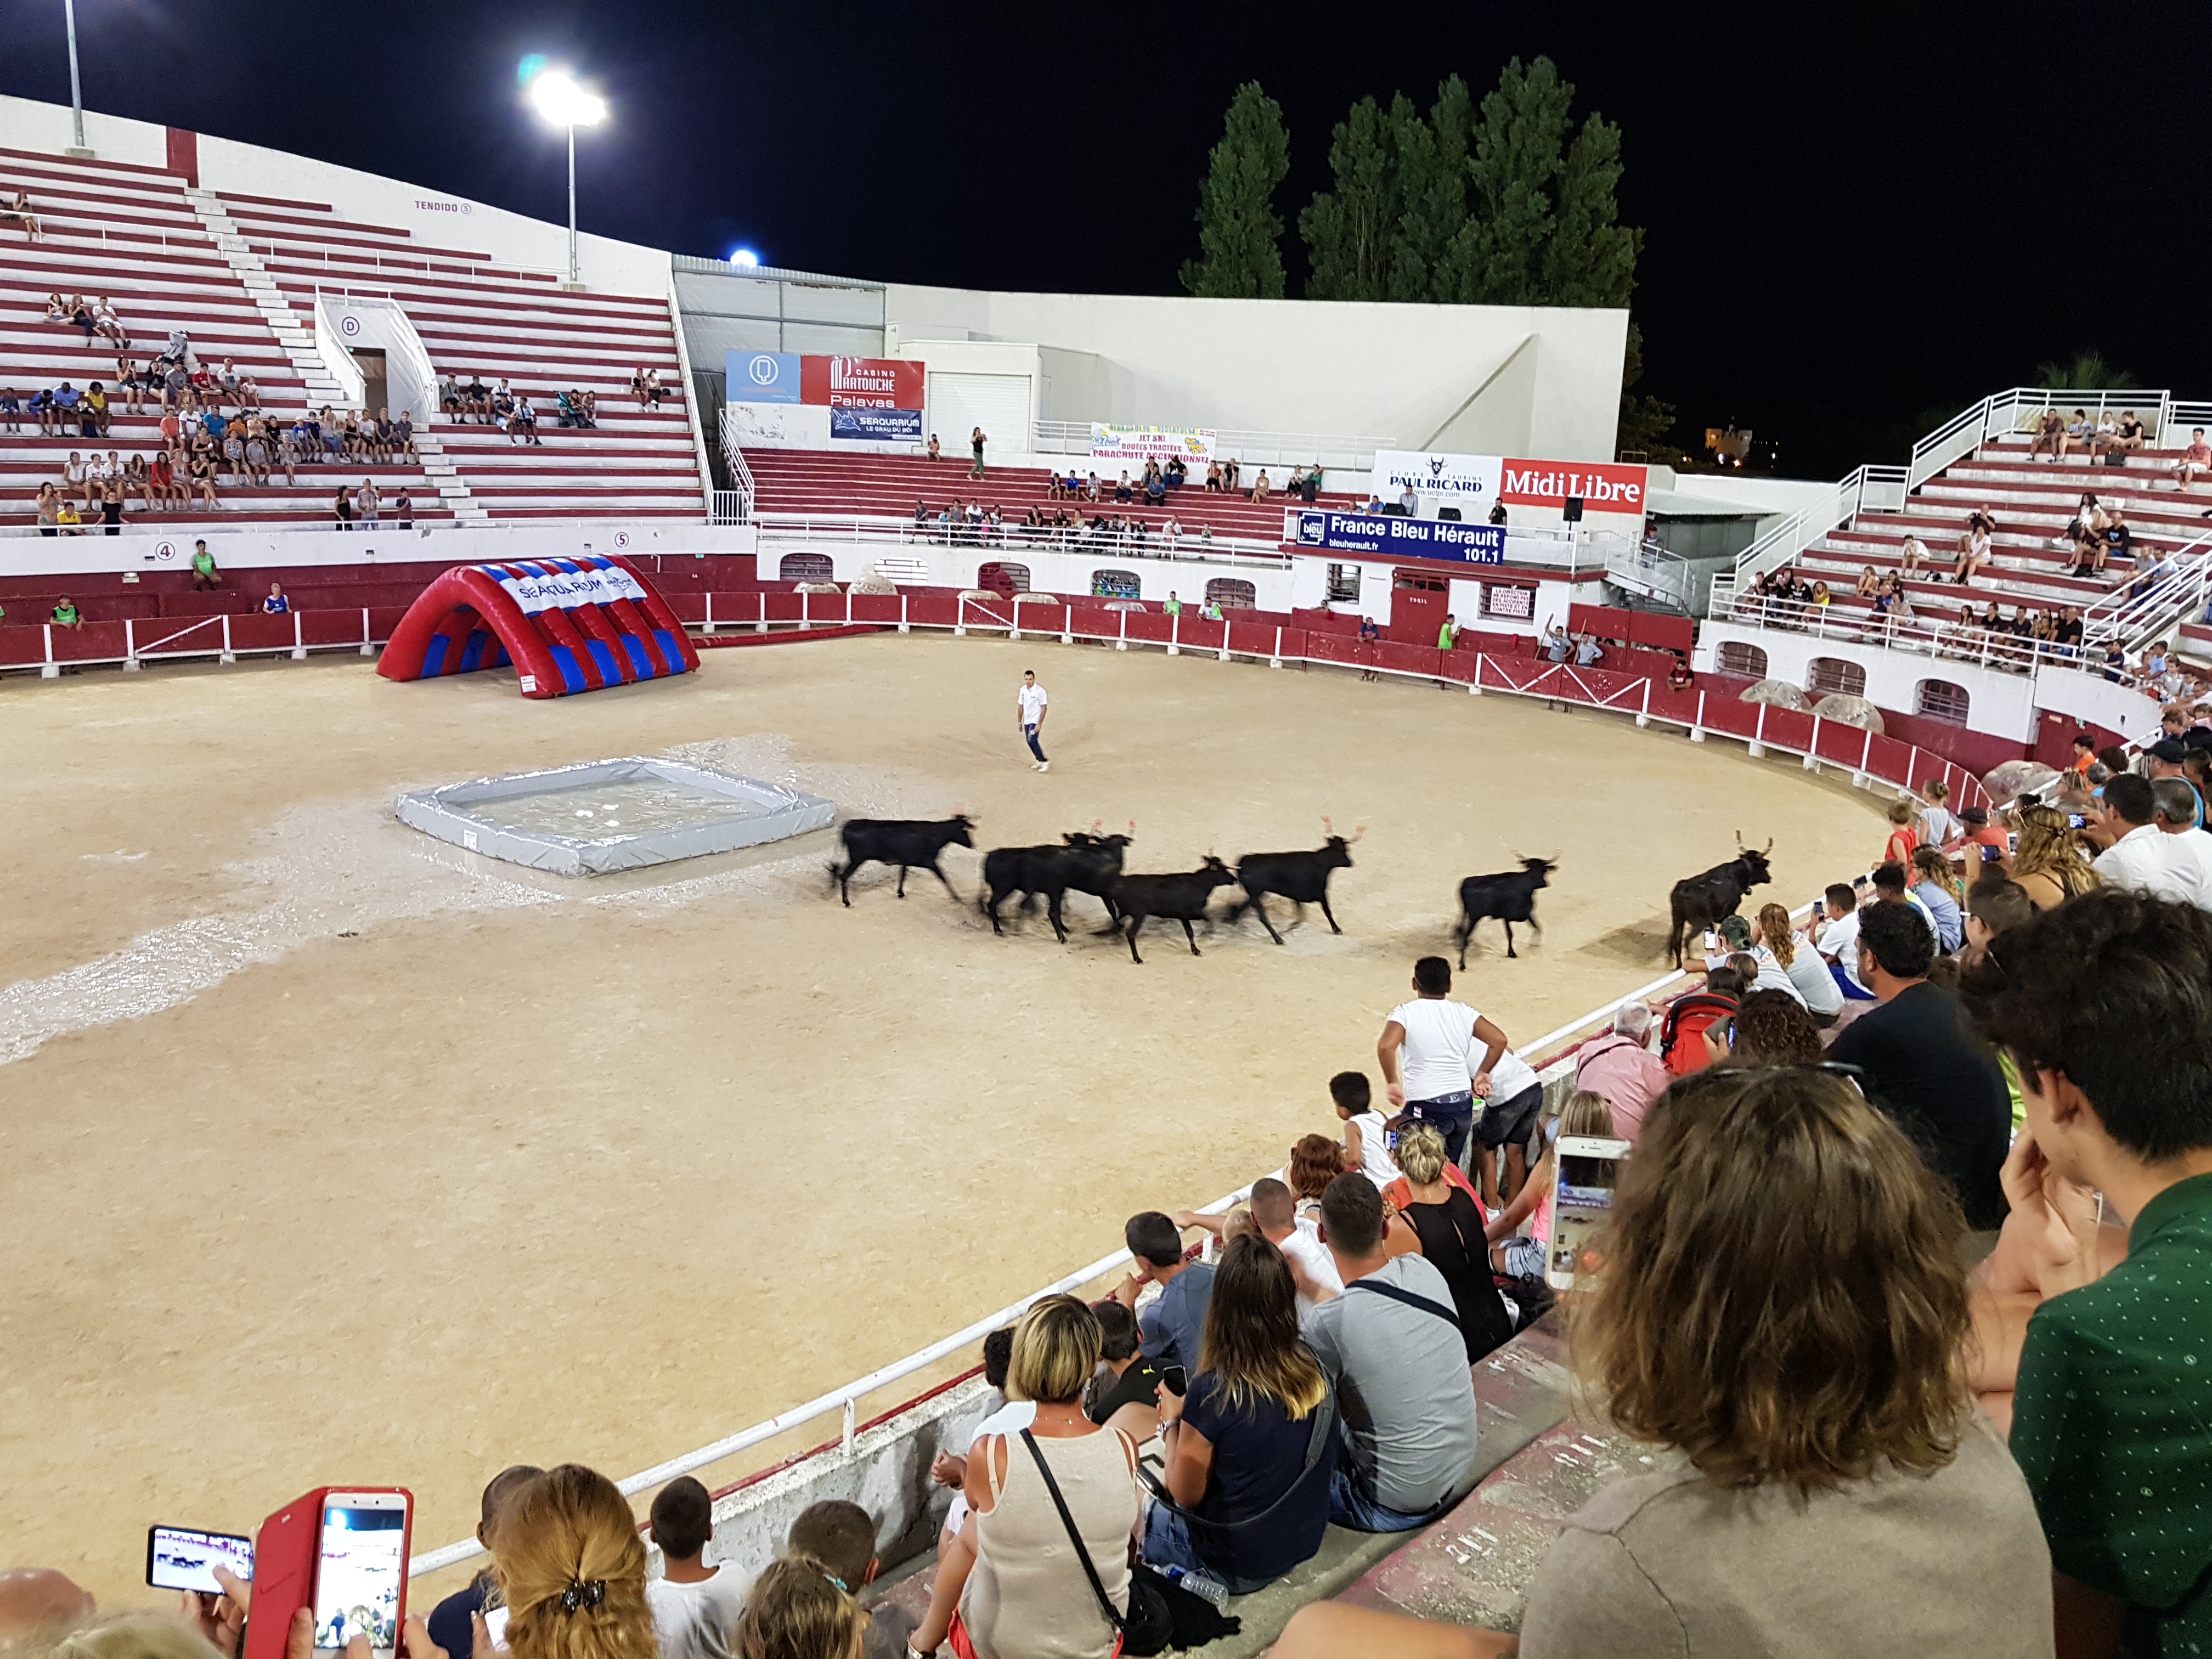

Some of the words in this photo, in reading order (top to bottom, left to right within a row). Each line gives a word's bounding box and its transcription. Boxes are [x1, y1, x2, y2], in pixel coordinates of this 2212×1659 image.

[415, 201, 458, 212] TENDIDO
[856, 369, 895, 377] CASINO
[831, 395, 895, 408] Palavas
[860, 417, 919, 427] SEAQUARIUM
[1149, 444, 1182, 452] TRACTÉES
[1093, 450, 1144, 459] PARACHUTE
[1147, 453, 1209, 464] ASCENIONNEL
[1390, 476, 1424, 488] PAUL
[1426, 479, 1482, 492] RICARD
[1504, 470, 1564, 496] Midi
[1567, 473, 1640, 503] Libre
[1414, 489, 1460, 498] ww.uctpr.com
[1304, 523, 1322, 534] bleu
[1331, 516, 1385, 536] France
[1391, 521, 1428, 540] Bleu
[1434, 524, 1499, 547] Hérault
[1329, 538, 1379, 551] bleuherault.fr
[160, 545, 170, 557] 4
[1464, 548, 1498, 563] 101.1
